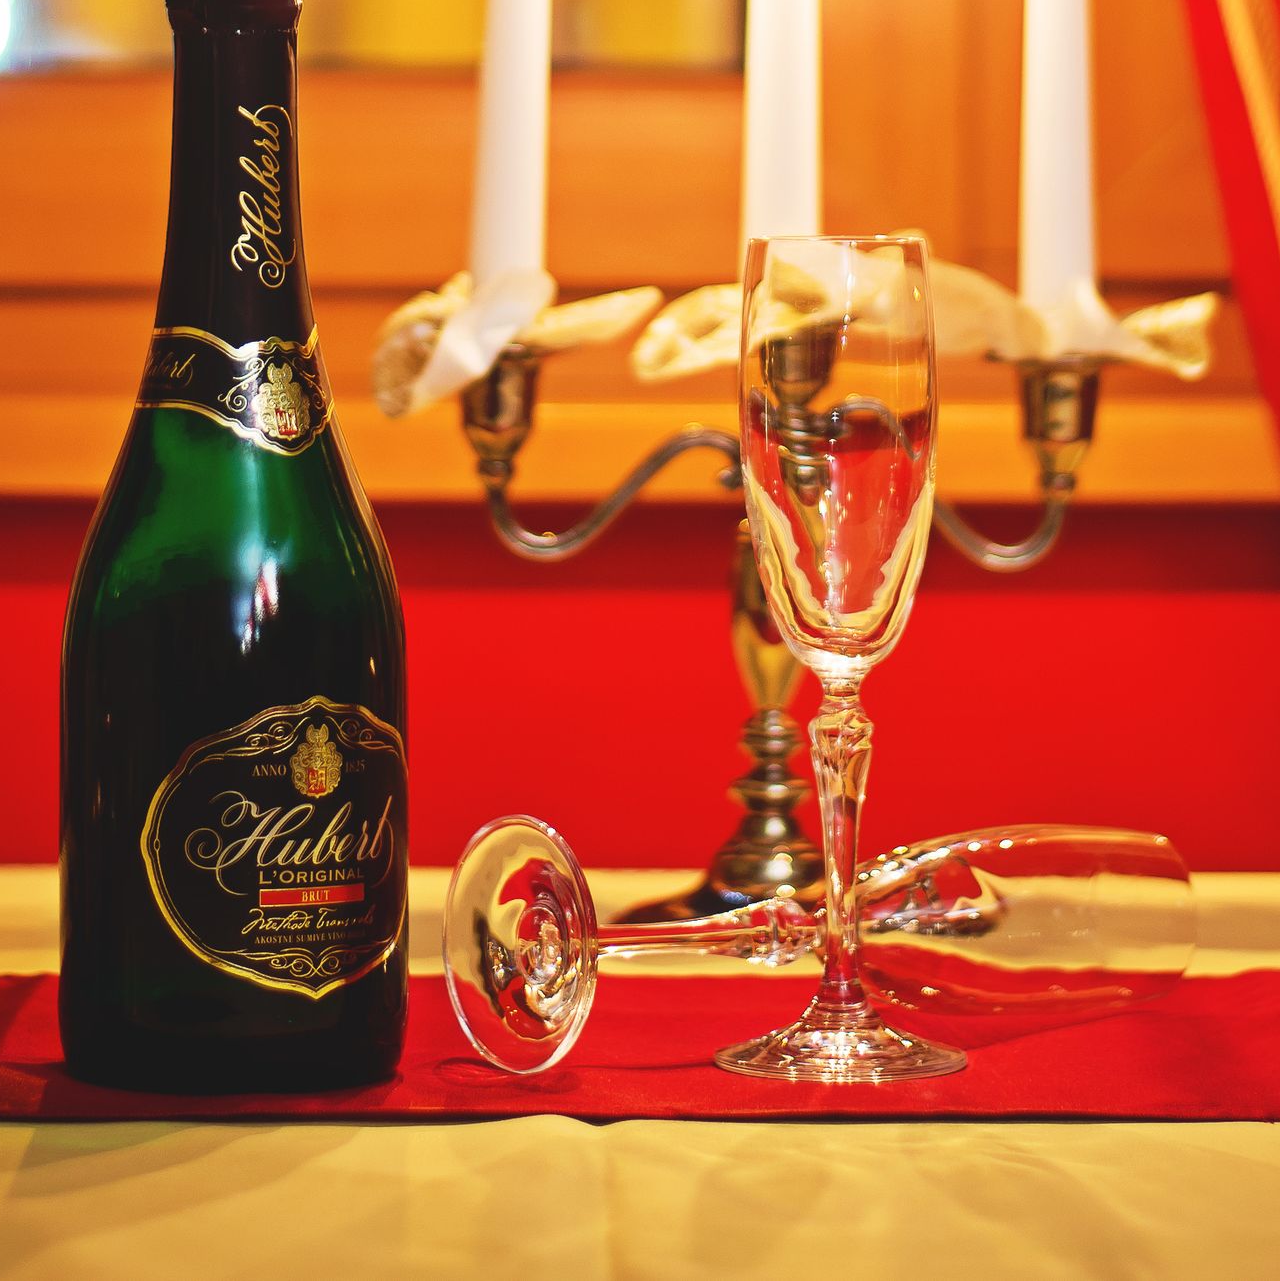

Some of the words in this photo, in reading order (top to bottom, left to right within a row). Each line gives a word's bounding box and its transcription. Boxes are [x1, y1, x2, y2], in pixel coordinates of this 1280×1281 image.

[231, 103, 297, 288] Hubert
[251, 763, 288, 778] ANNO
[184, 790, 394, 896] Hubert
[258, 867, 365, 885] L'ORIGINAL
[301, 889, 331, 903] BRUT
